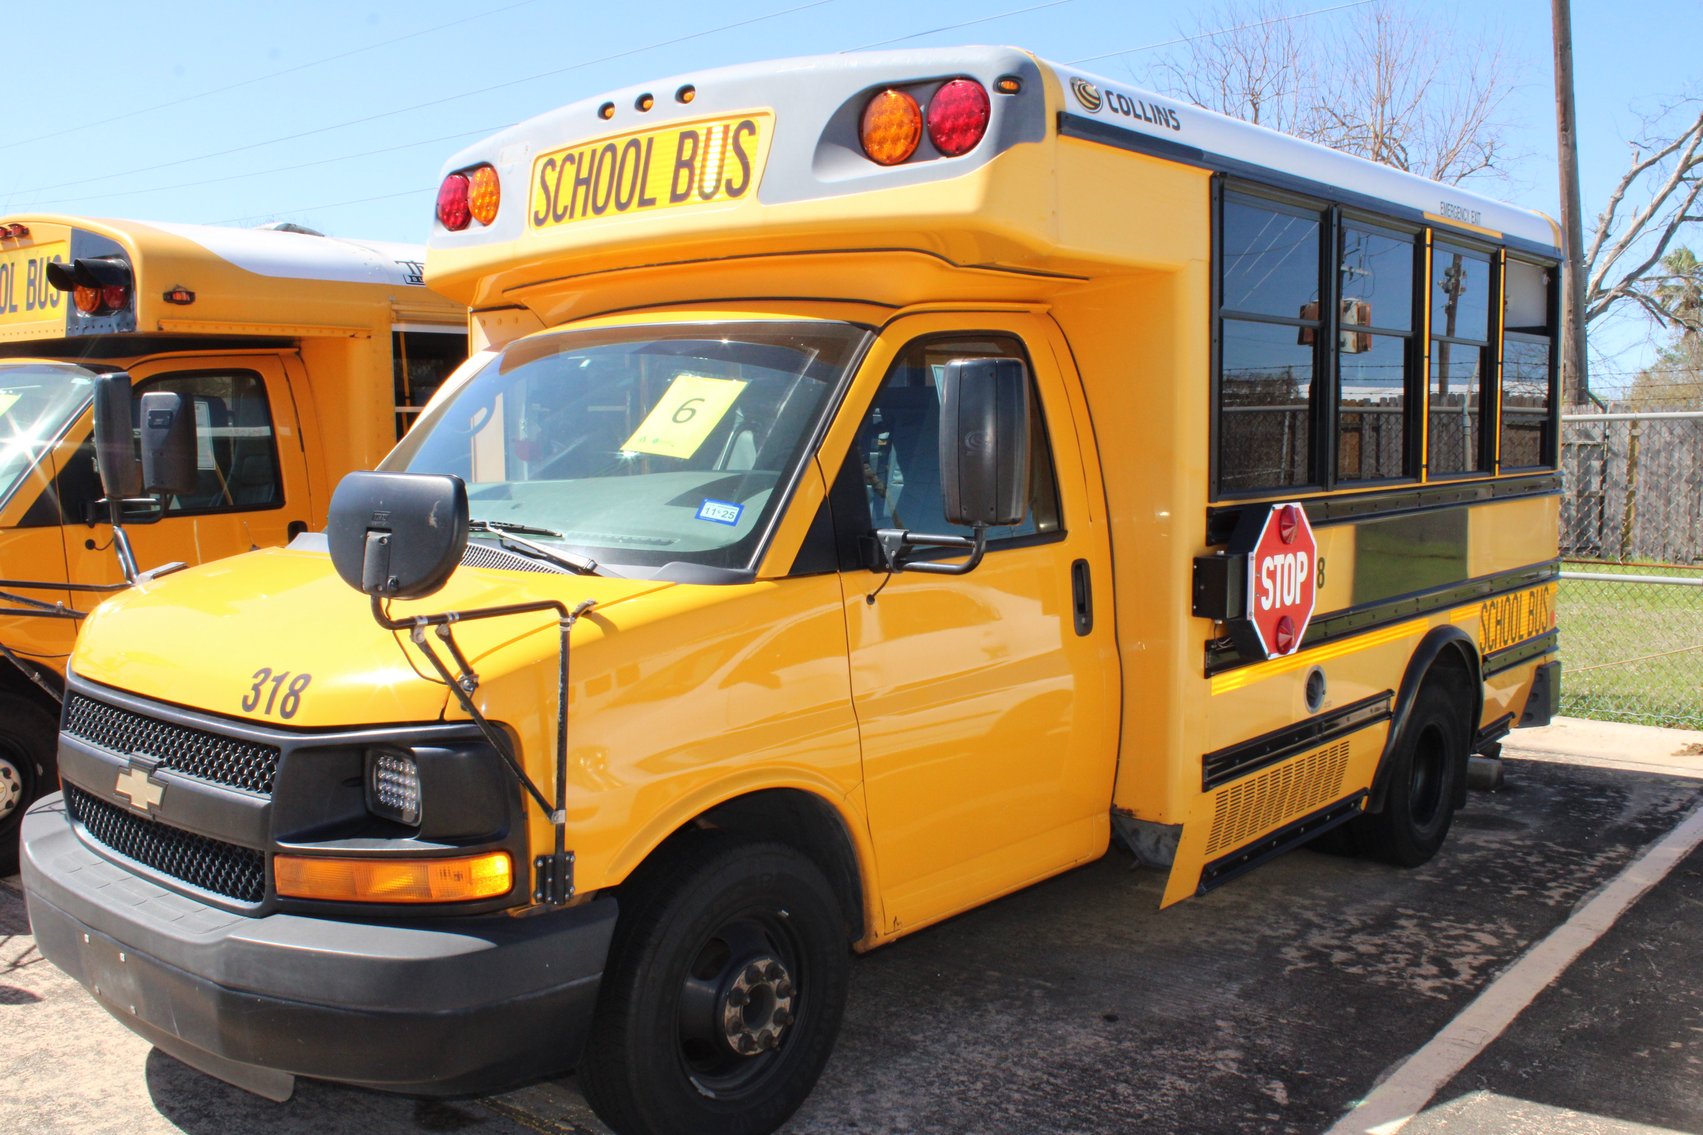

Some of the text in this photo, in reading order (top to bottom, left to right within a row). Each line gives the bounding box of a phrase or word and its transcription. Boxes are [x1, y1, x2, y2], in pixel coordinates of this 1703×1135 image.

[1105, 89, 1181, 131] COLLINS
[533, 119, 757, 228] SCHOOL BUS
[1440, 201, 1482, 225] EMERGENCY EXIT
[671, 397, 705, 424] 6
[1261, 551, 1309, 612] STOP
[1480, 585, 1550, 654] SCHOOL BUS
[241, 667, 313, 720] 318
